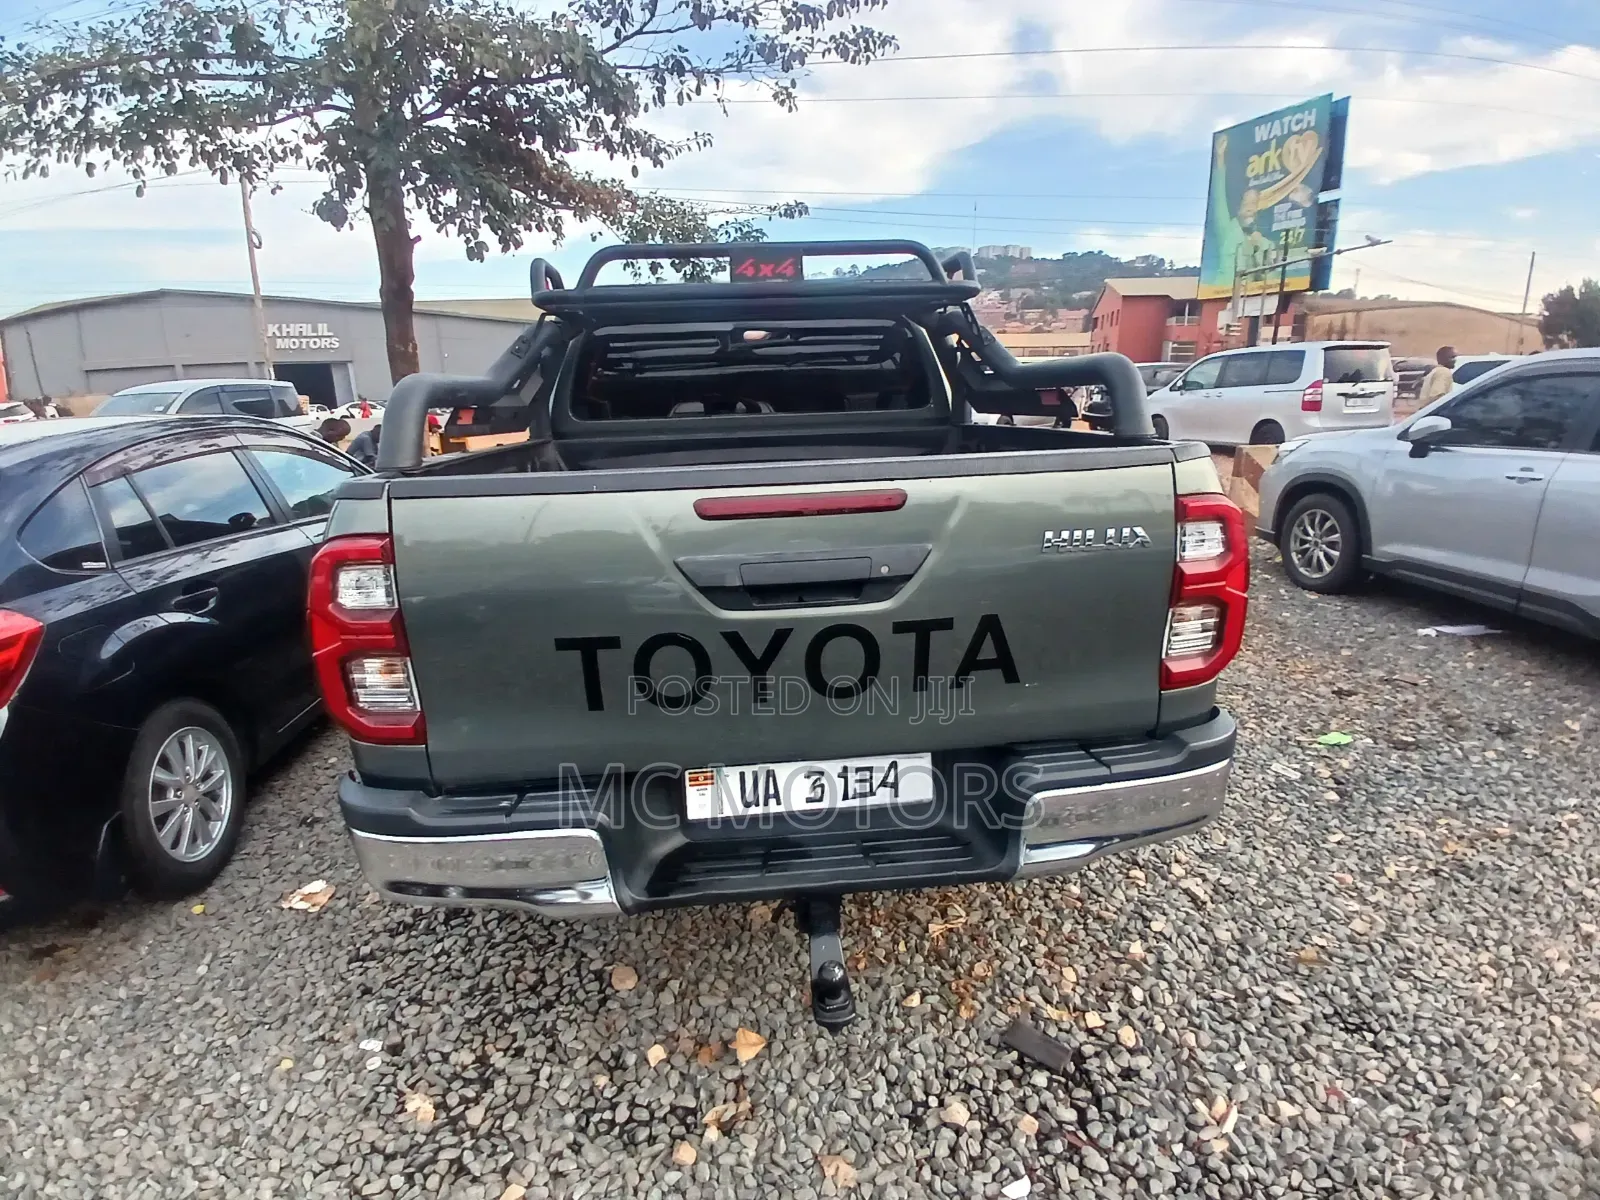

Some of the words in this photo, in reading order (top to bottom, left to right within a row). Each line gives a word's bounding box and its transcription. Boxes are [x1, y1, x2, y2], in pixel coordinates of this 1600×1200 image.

[1255, 108, 1317, 143] WATCH
[1246, 139, 1282, 178] ark
[267, 323, 334, 337] KHALIL
[275, 337, 340, 349] MOTORS
[554, 613, 1021, 712] TOYOTA
[739, 768, 782, 809] UA
